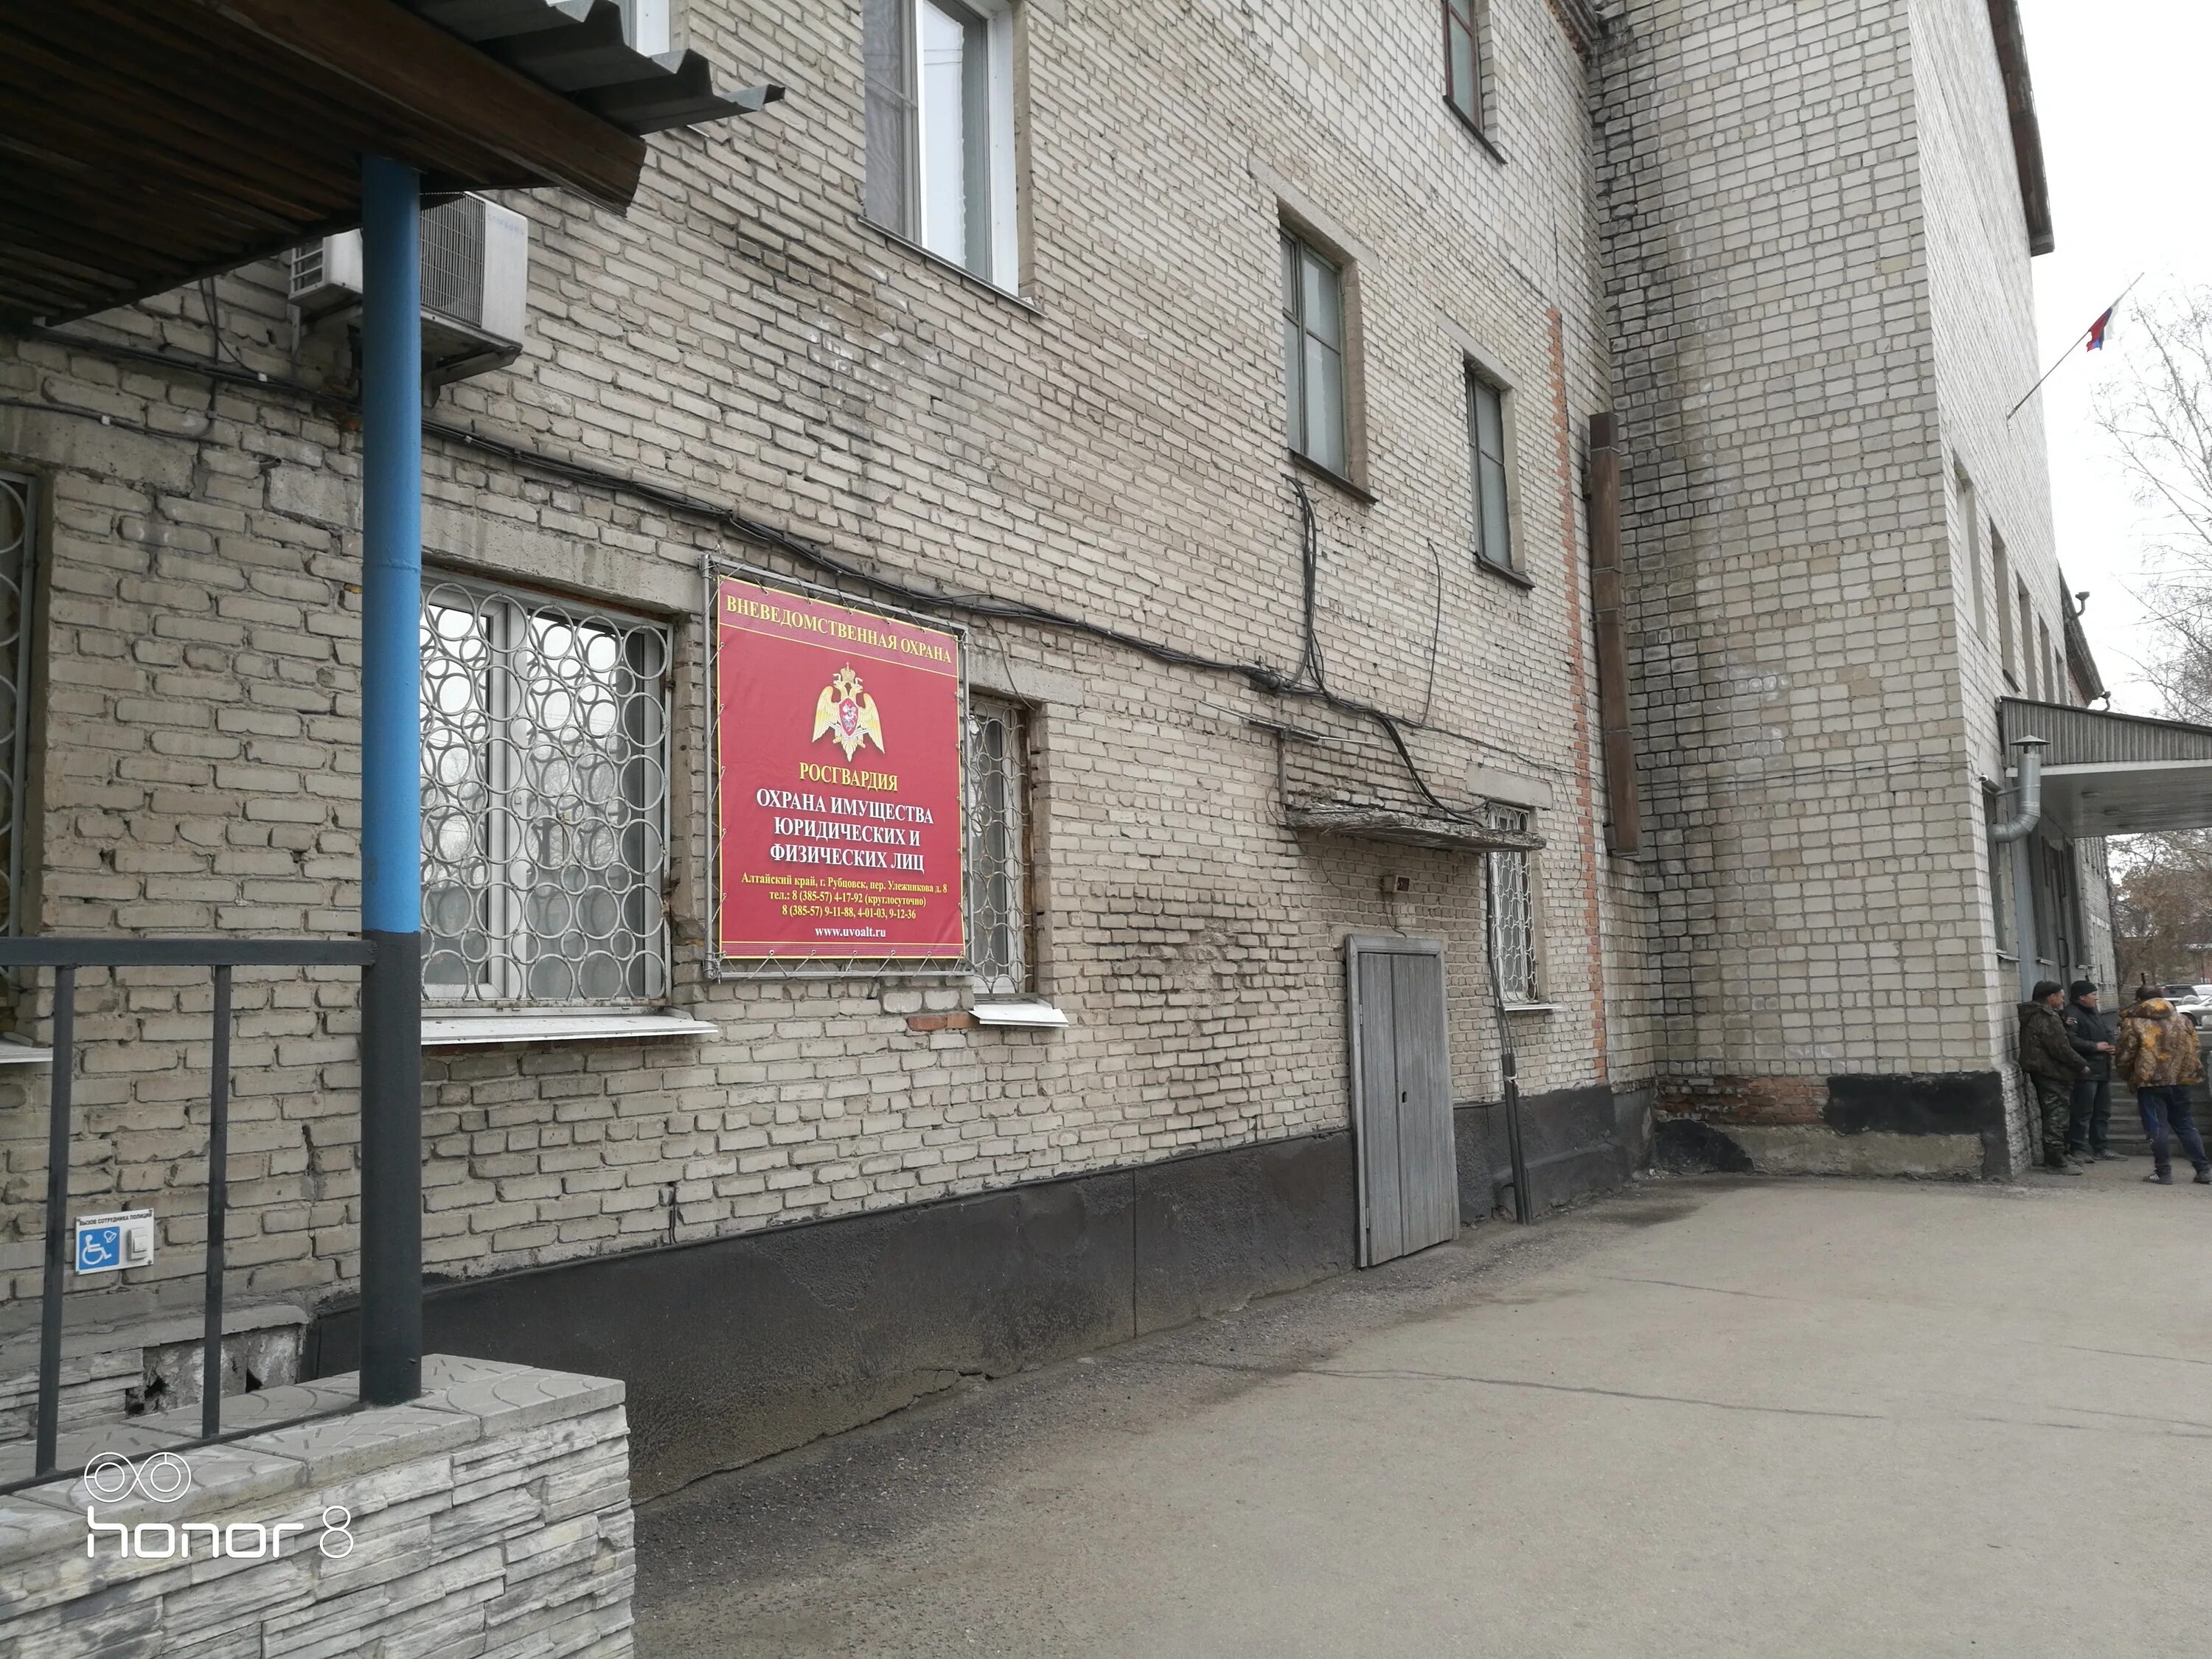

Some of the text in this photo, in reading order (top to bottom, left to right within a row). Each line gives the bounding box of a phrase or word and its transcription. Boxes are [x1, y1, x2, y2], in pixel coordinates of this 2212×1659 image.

[726, 595, 951, 663] ВНЕВЕДОМСТВЕННАЯ ОХРАНА
[799, 762, 897, 792] РОСГВАРДИЯ
[757, 788, 933, 824] ОХРАНА ИМУЩЕСТВА
[774, 817, 920, 846] ЮРИДИЧЕСКИХ И
[771, 844, 925, 874] ФИЗИЧЕСКИХ ЛИЦ
[742, 872, 792, 885] Алтайский
[795, 877, 818, 888] край,
[828, 877, 869, 890] Рубцовск,
[870, 881, 886, 892] пер.
[888, 880, 933, 892] Улежникова
[935, 886, 942, 894] д.
[943, 883, 947, 893] 8
[769, 890, 926, 908] тел.: 8 (385-57) 4-17-92 (круглосуточно)
[782, 905, 917, 919] 8 (385-57) 9-11-88, 4-01-03, 9-12-36
[815, 925, 886, 938] www.uvoalt.ru
